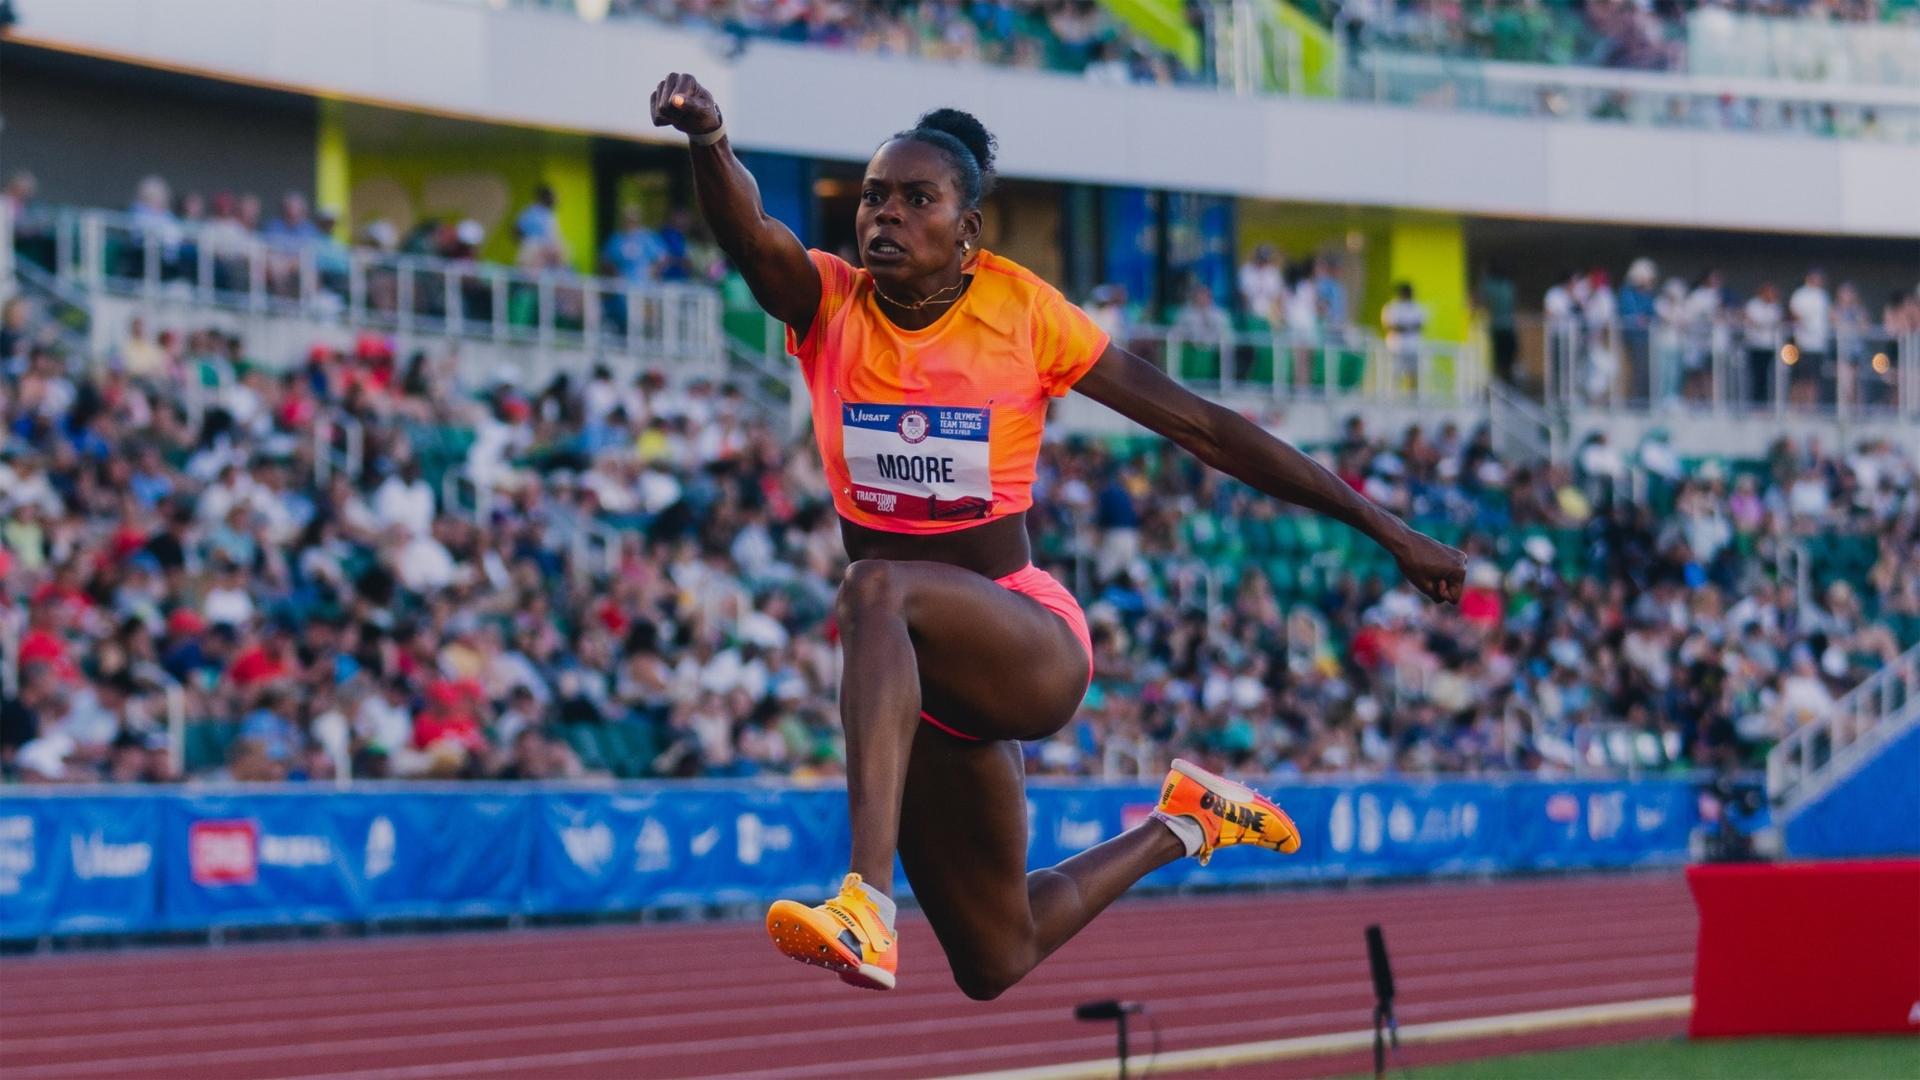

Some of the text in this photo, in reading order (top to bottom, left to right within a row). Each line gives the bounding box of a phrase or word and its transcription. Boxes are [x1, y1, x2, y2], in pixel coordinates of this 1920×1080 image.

[862, 413, 891, 422] USATF
[940, 411, 982, 421] U.S. OLYMPIC
[940, 420, 982, 430] TEAM TRIALS
[877, 453, 955, 483] MOORE
[856, 490, 897, 504] TRACKTOWN
[877, 502, 894, 512] 2024
